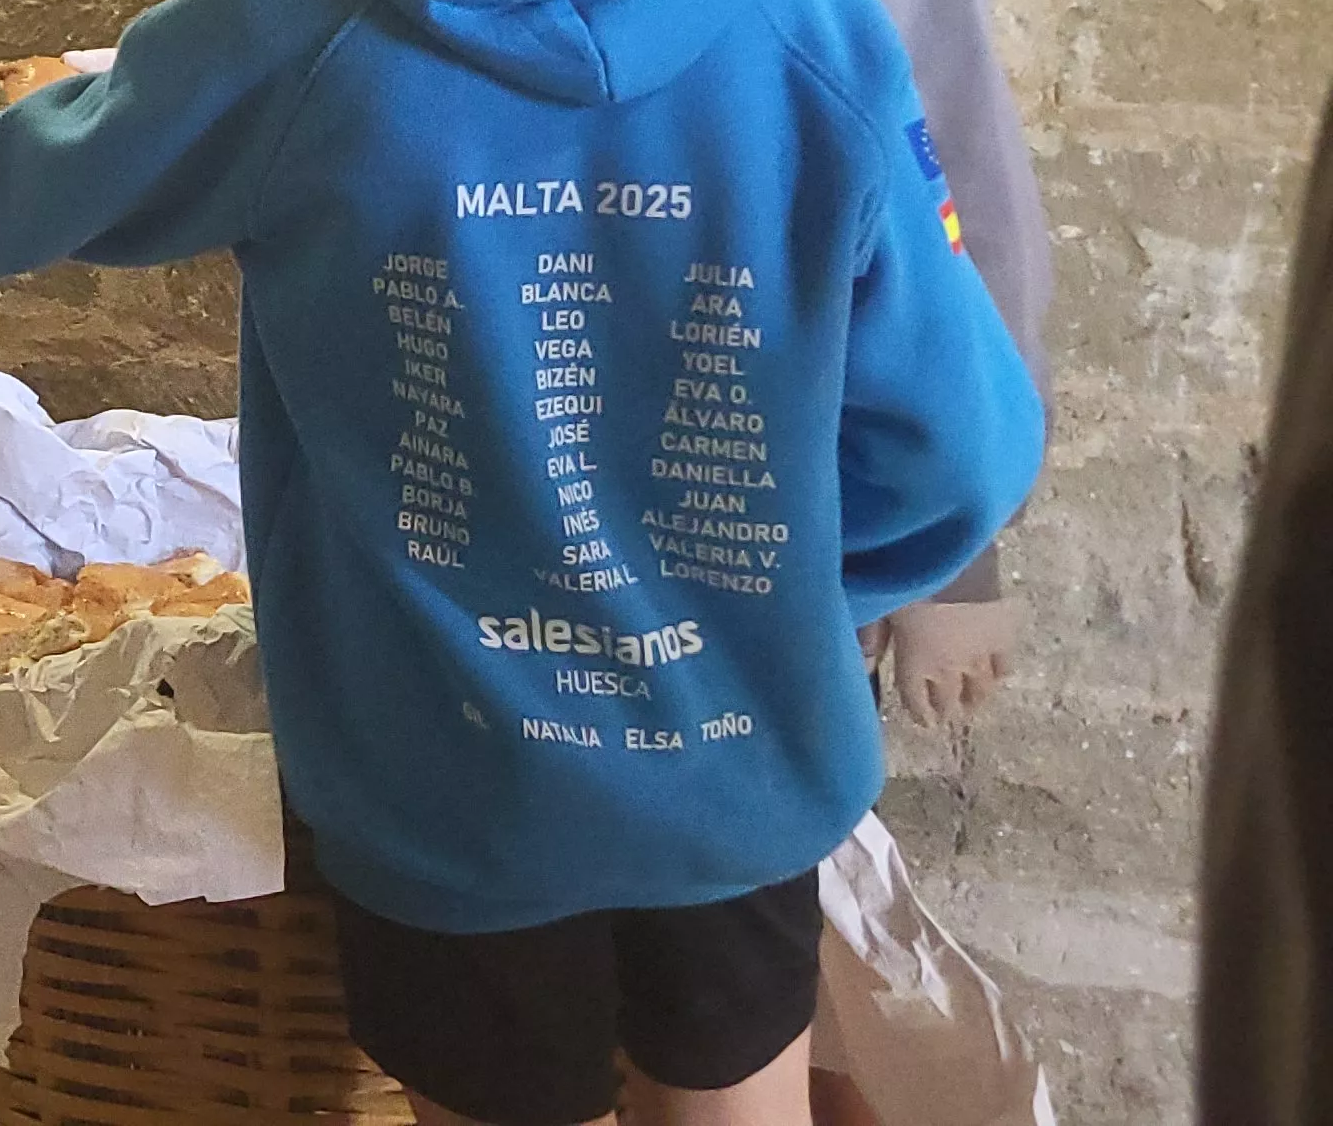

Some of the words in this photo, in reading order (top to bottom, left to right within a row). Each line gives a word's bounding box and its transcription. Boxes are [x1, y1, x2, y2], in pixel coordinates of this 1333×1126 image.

[457, 180, 583, 219] MALTA
[596, 181, 693, 219] 2025
[383, 253, 449, 279] JORGE
[537, 252, 594, 274] DANI
[684, 262, 755, 289] JULIA
[372, 277, 438, 305] PABLO
[443, 289, 466, 310] A.
[520, 281, 613, 305] BLANCA
[691, 294, 743, 318] ARA
[387, 305, 452, 336] BELÉN
[541, 309, 585, 331] LEO
[670, 320, 762, 348] LORIÉN
[396, 331, 449, 361] HUGO
[534, 338, 593, 361] VEGA
[404, 359, 447, 388] IKER
[683, 351, 746, 376] YOEL
[391, 378, 466, 419] NAYARA
[674, 378, 722, 402] EVA
[534, 395, 603, 421] EZEQUI
[663, 399, 765, 434] ÁLVARO
[414, 410, 449, 438] PAZ
[547, 419, 591, 449] JOSÉ
[398, 431, 470, 471] AINARA
[660, 431, 767, 462] CARMEN
[390, 454, 453, 490] PABLO
[546, 454, 577, 478] EVA
[651, 458, 777, 489] DANIELLA
[402, 484, 468, 521] BORJA
[557, 479, 594, 507] NICO
[678, 489, 746, 514] JUAN
[397, 510, 470, 547] BRUNO
[562, 506, 600, 538] INÉS
[640, 509, 789, 544] ALEJANDRO
[407, 539, 466, 569] RAÚL
[562, 539, 612, 566] SARA
[648, 533, 751, 569] VALERIA
[758, 550, 782, 570] V.
[660, 559, 773, 594] LORENZO
[477, 606, 704, 667] salesianos
[555, 670, 652, 701] HUESCA
[522, 718, 603, 749] NATALIA
[625, 728, 684, 751] ELSA
[700, 711, 753, 742] TOÑO
